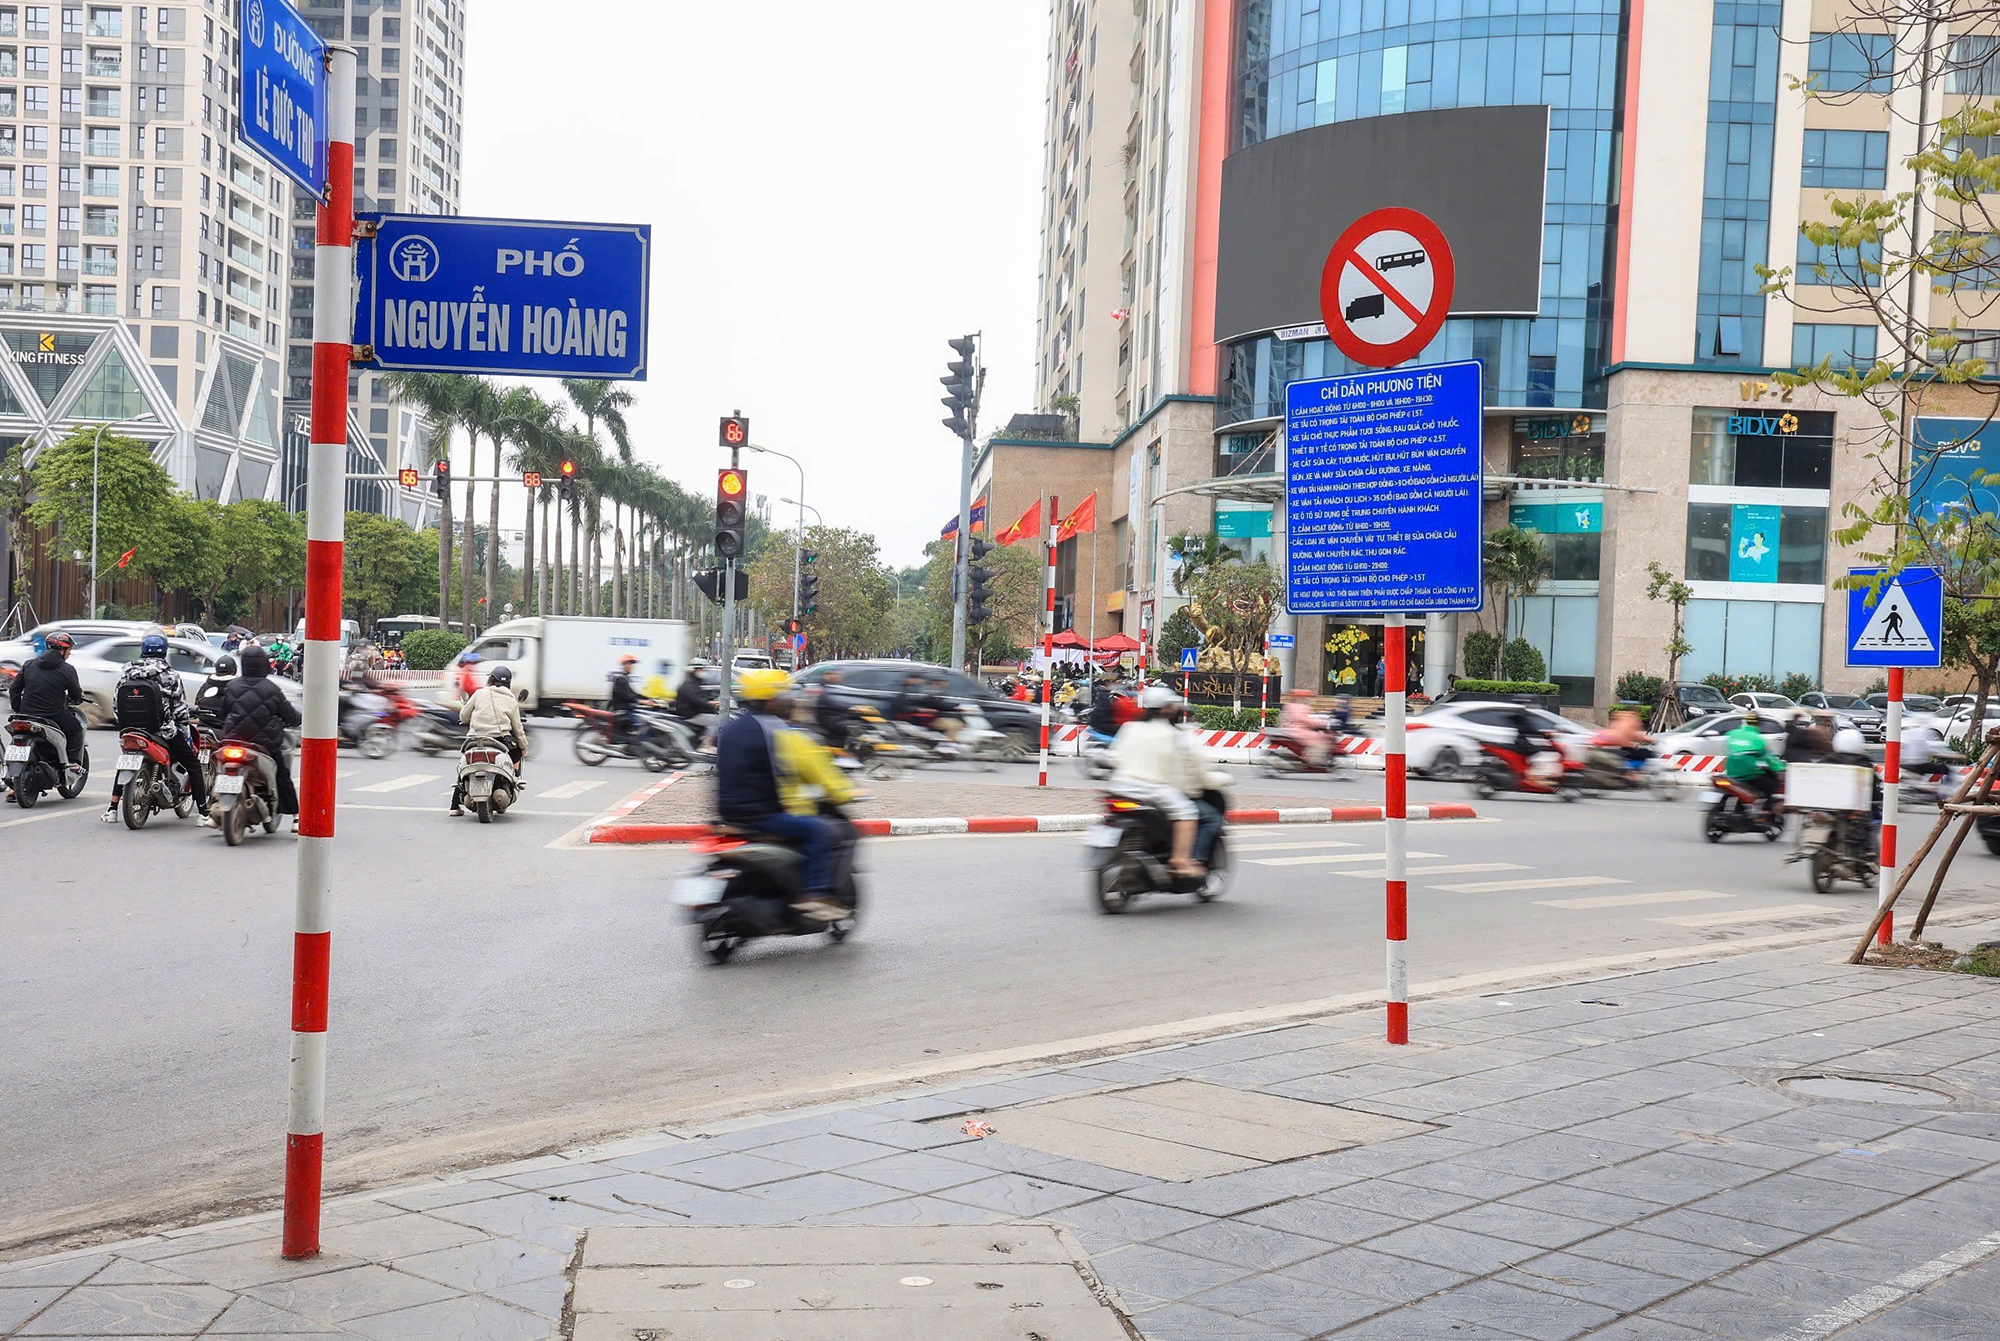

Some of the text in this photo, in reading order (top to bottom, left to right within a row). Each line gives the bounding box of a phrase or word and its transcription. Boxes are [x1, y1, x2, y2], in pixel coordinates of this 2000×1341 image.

[274, 21, 315, 86] ĐƯỜNG
[256, 65, 314, 178] LÊ ĐỨC THỌ
[496, 238, 585, 277] PHỐ
[384, 285, 628, 358] NGUYỄN HOÀNG
[1280, 328, 1309, 338] BIZMAN
[8, 351, 85, 365] KING FITNESS
[1320, 371, 1441, 399] CHỈ DẪN PHƯƠNG TIỆN
[1740, 381, 1794, 402] VP-2
[1528, 420, 1572, 440] BIDV
[1728, 416, 1779, 436] BIDV
[402, 471, 416, 484] 66
